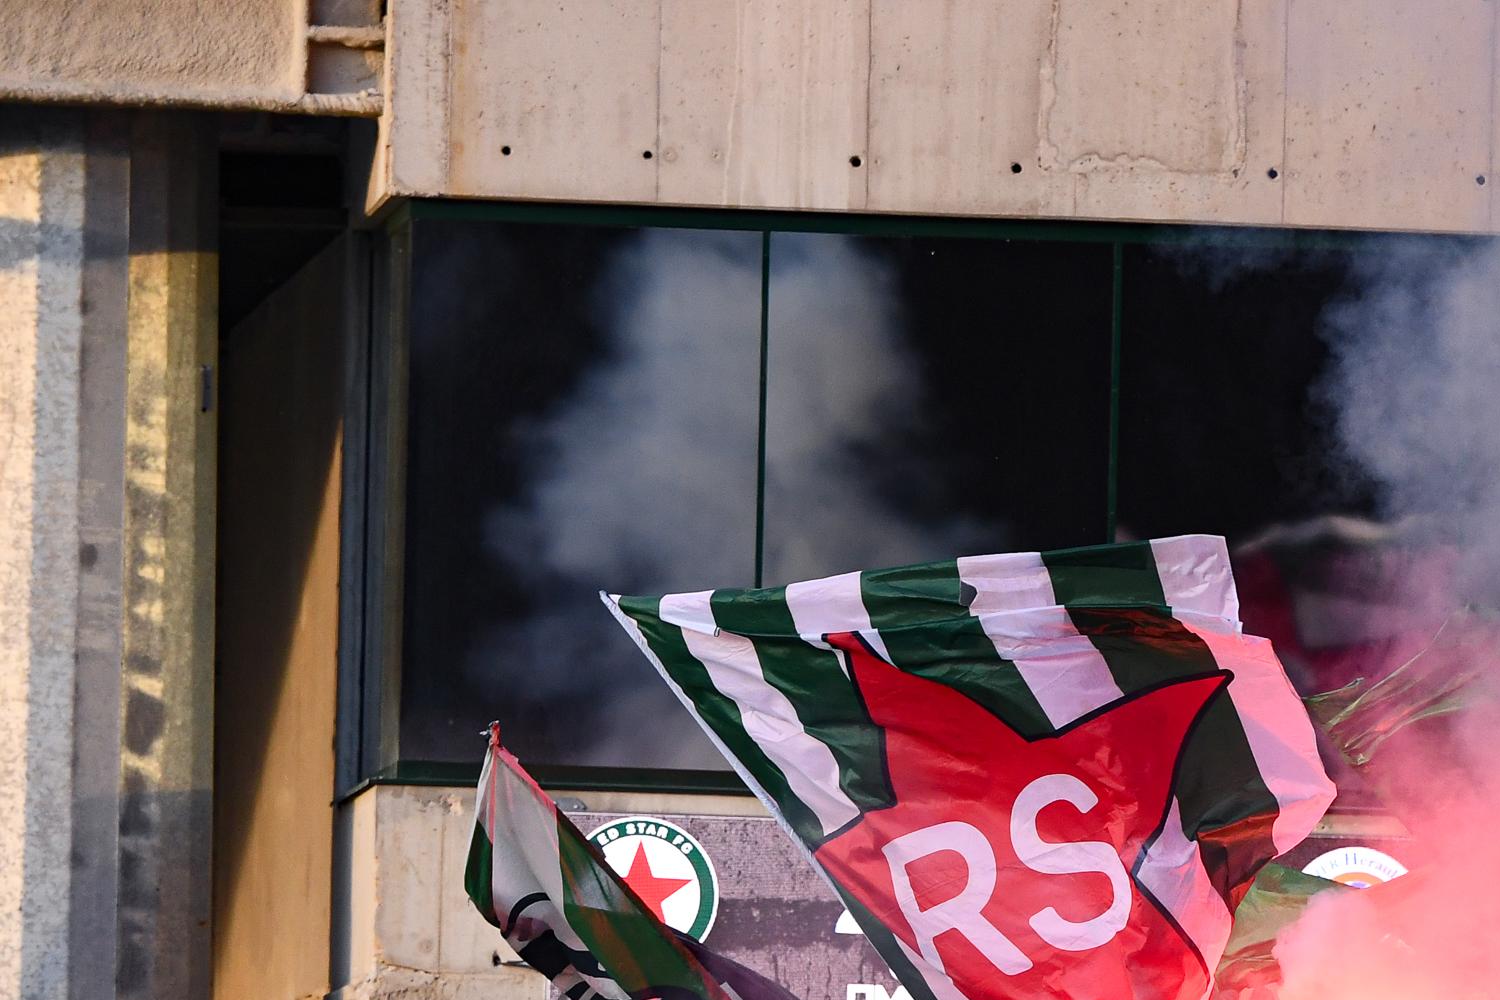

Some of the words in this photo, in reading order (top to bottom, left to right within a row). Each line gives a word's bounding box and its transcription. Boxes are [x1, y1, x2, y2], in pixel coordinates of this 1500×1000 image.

[597, 827, 620, 846] ED
[625, 822, 668, 840] STAR
[671, 834, 694, 855] FC
[881, 773, 1133, 976] RS
